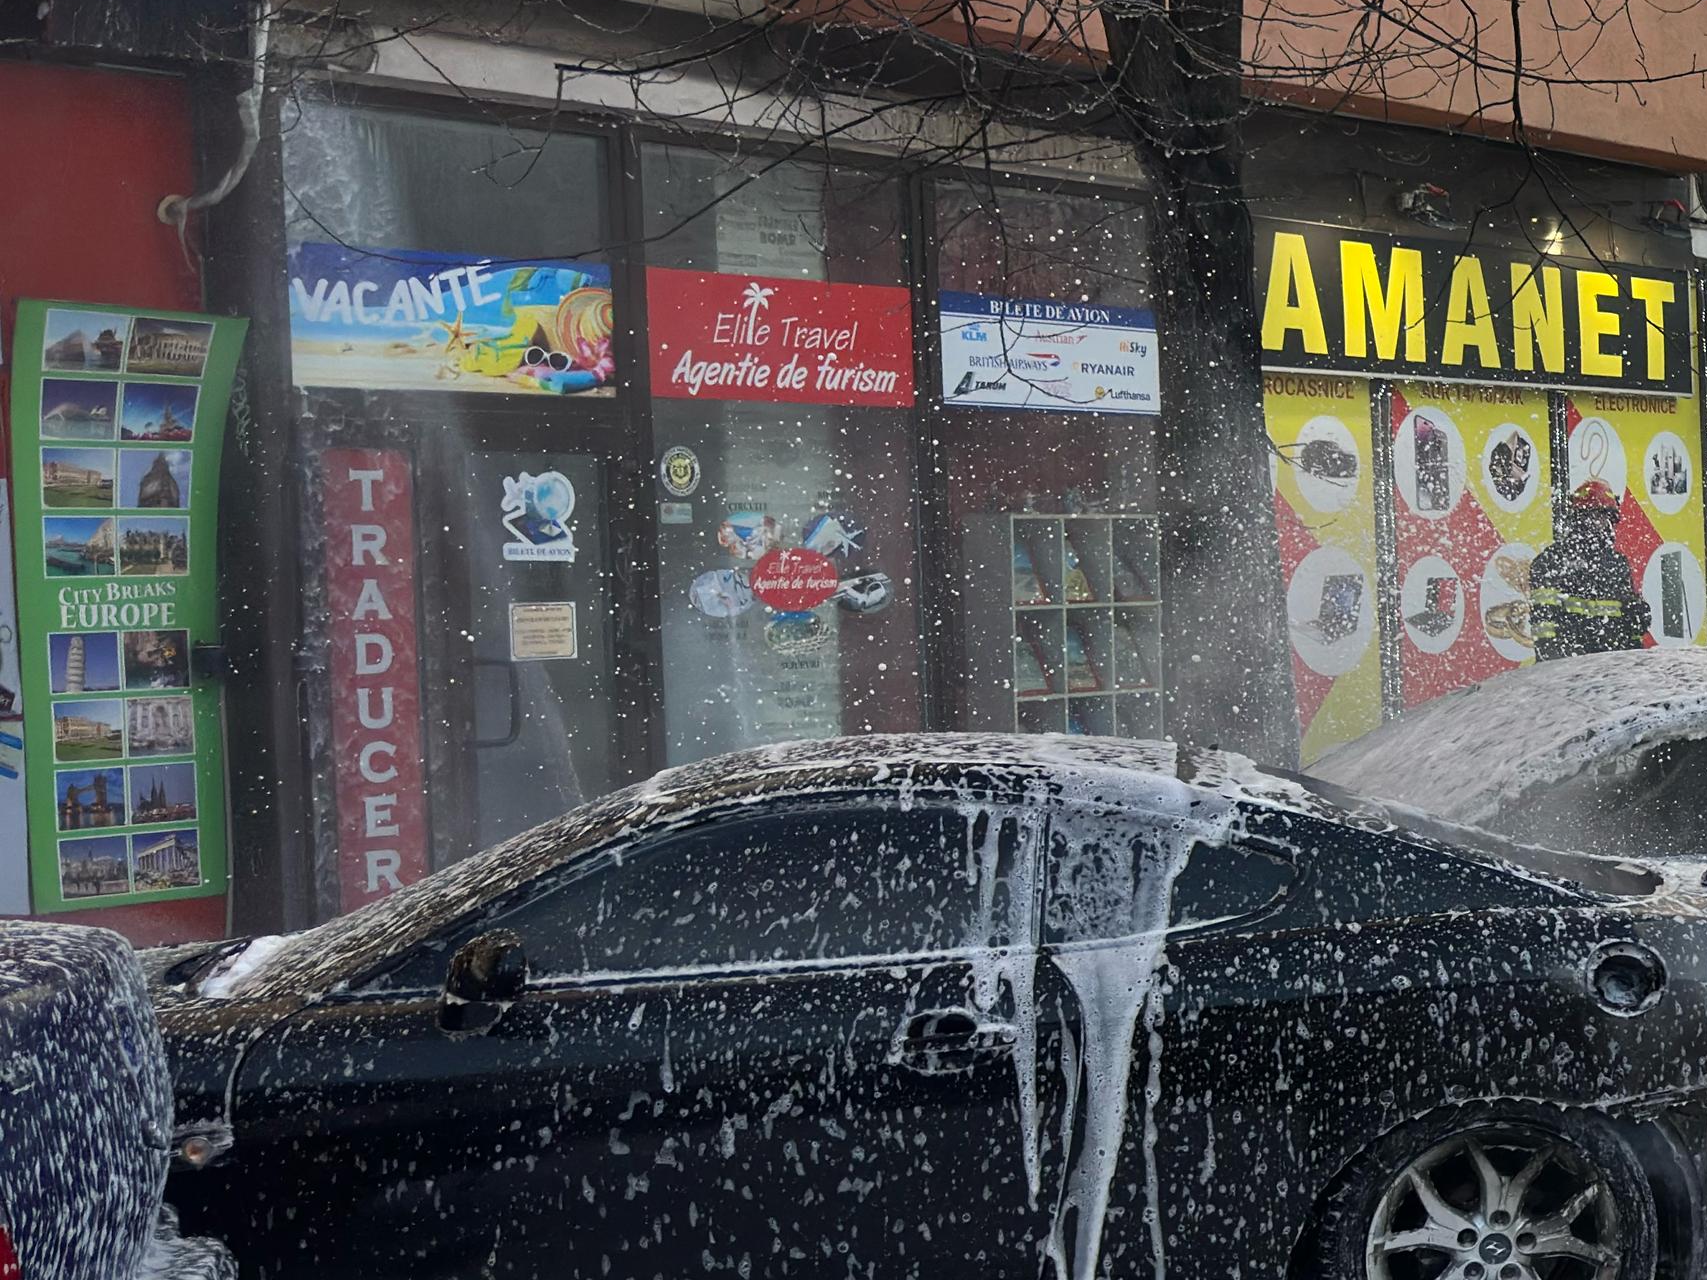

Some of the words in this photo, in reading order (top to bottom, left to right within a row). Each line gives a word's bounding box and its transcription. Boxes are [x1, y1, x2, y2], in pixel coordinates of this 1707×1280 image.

[291, 258, 502, 326] VACANTE
[989, 300, 1043, 318] BILETE
[1045, 304, 1061, 319] DE
[1064, 306, 1111, 323] AVION
[1261, 231, 1676, 382] AMANET
[781, 317, 859, 351] Travel
[961, 330, 988, 342] KLM
[671, 349, 772, 396] Agentie
[776, 353, 809, 390] de
[968, 355, 1007, 369] BRITISH
[1081, 362, 1135, 377] RYANAIR
[1110, 387, 1151, 401] Lufthansa
[1595, 394, 1677, 415] ELECTRONICE
[60, 602, 177, 629] EUROPE
